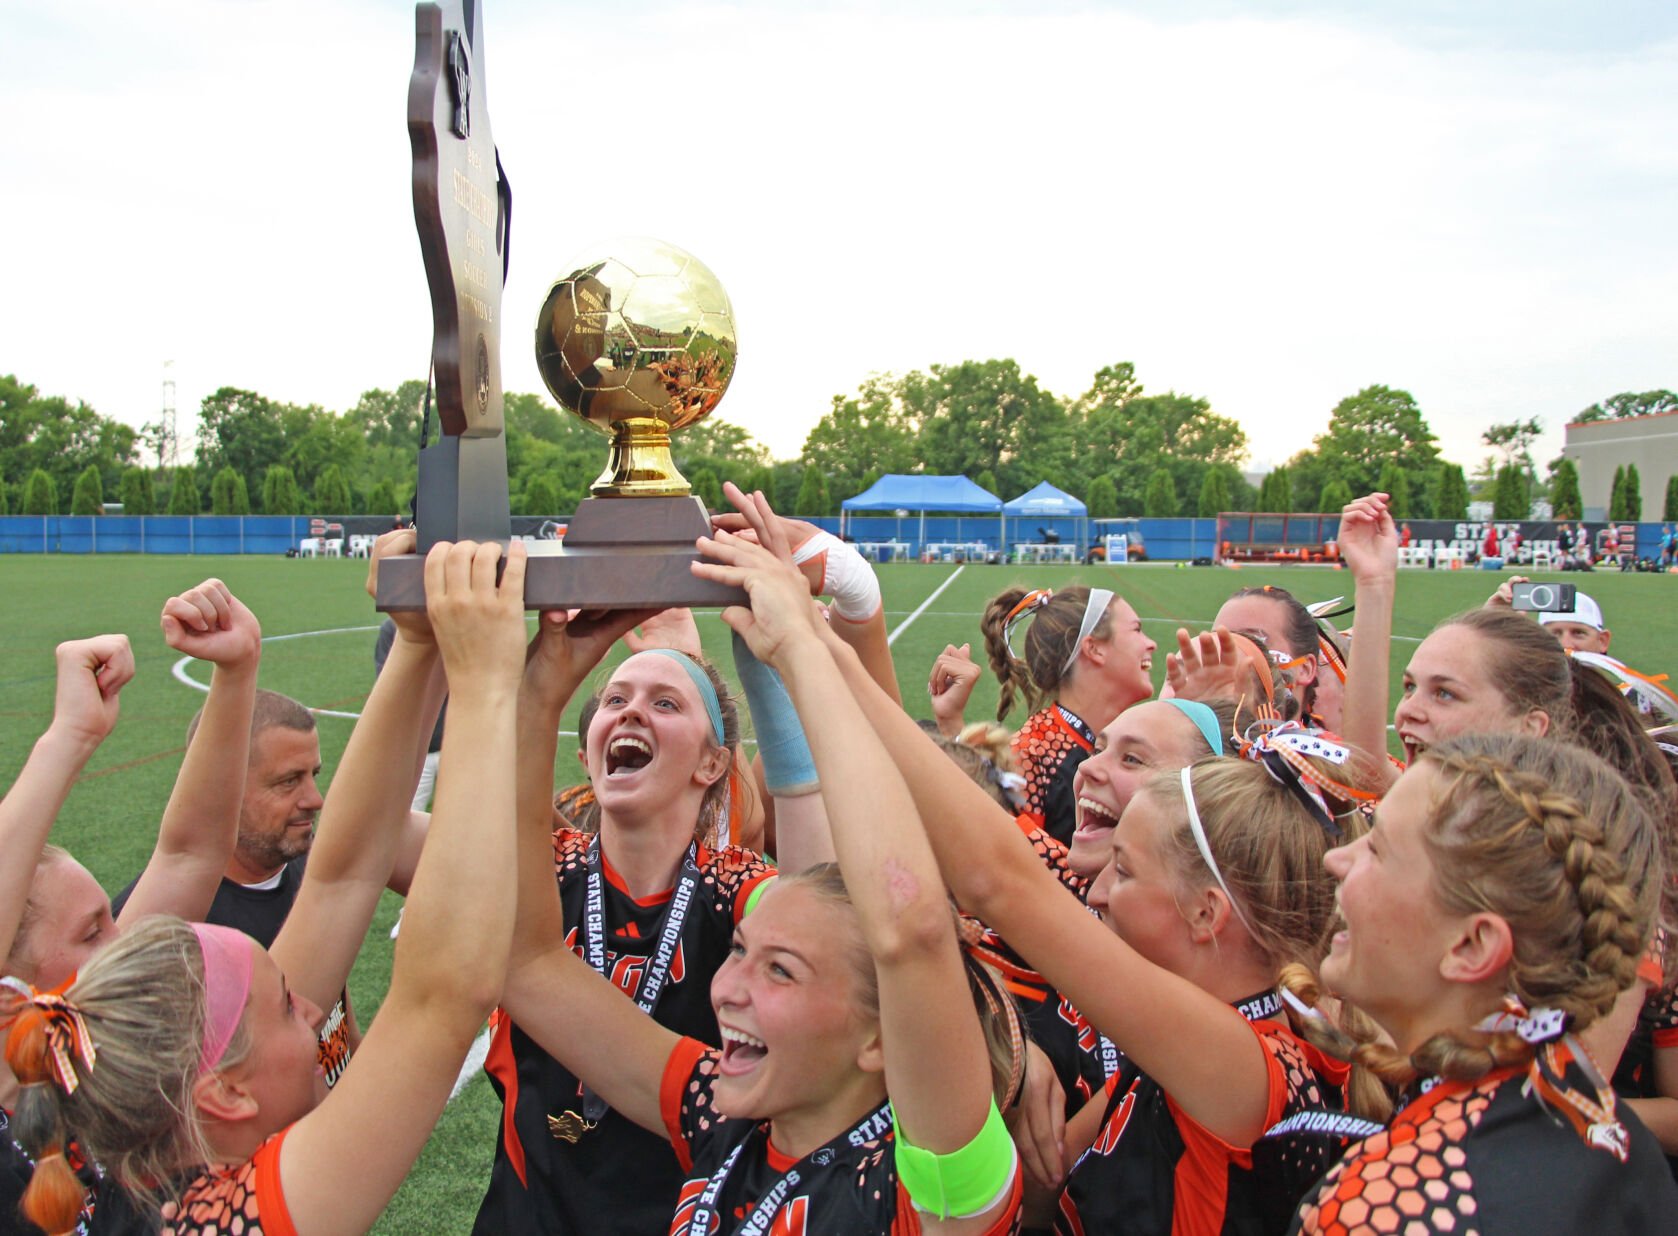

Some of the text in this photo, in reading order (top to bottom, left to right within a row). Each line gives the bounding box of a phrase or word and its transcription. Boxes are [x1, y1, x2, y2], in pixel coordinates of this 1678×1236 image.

[464, 260, 488, 289] SOCCER
[587, 872, 602, 912] STATE
[643, 876, 694, 1000] CHAMPIONSHIPS
[847, 1103, 894, 1147] STAT
[699, 1144, 743, 1205] STATE
